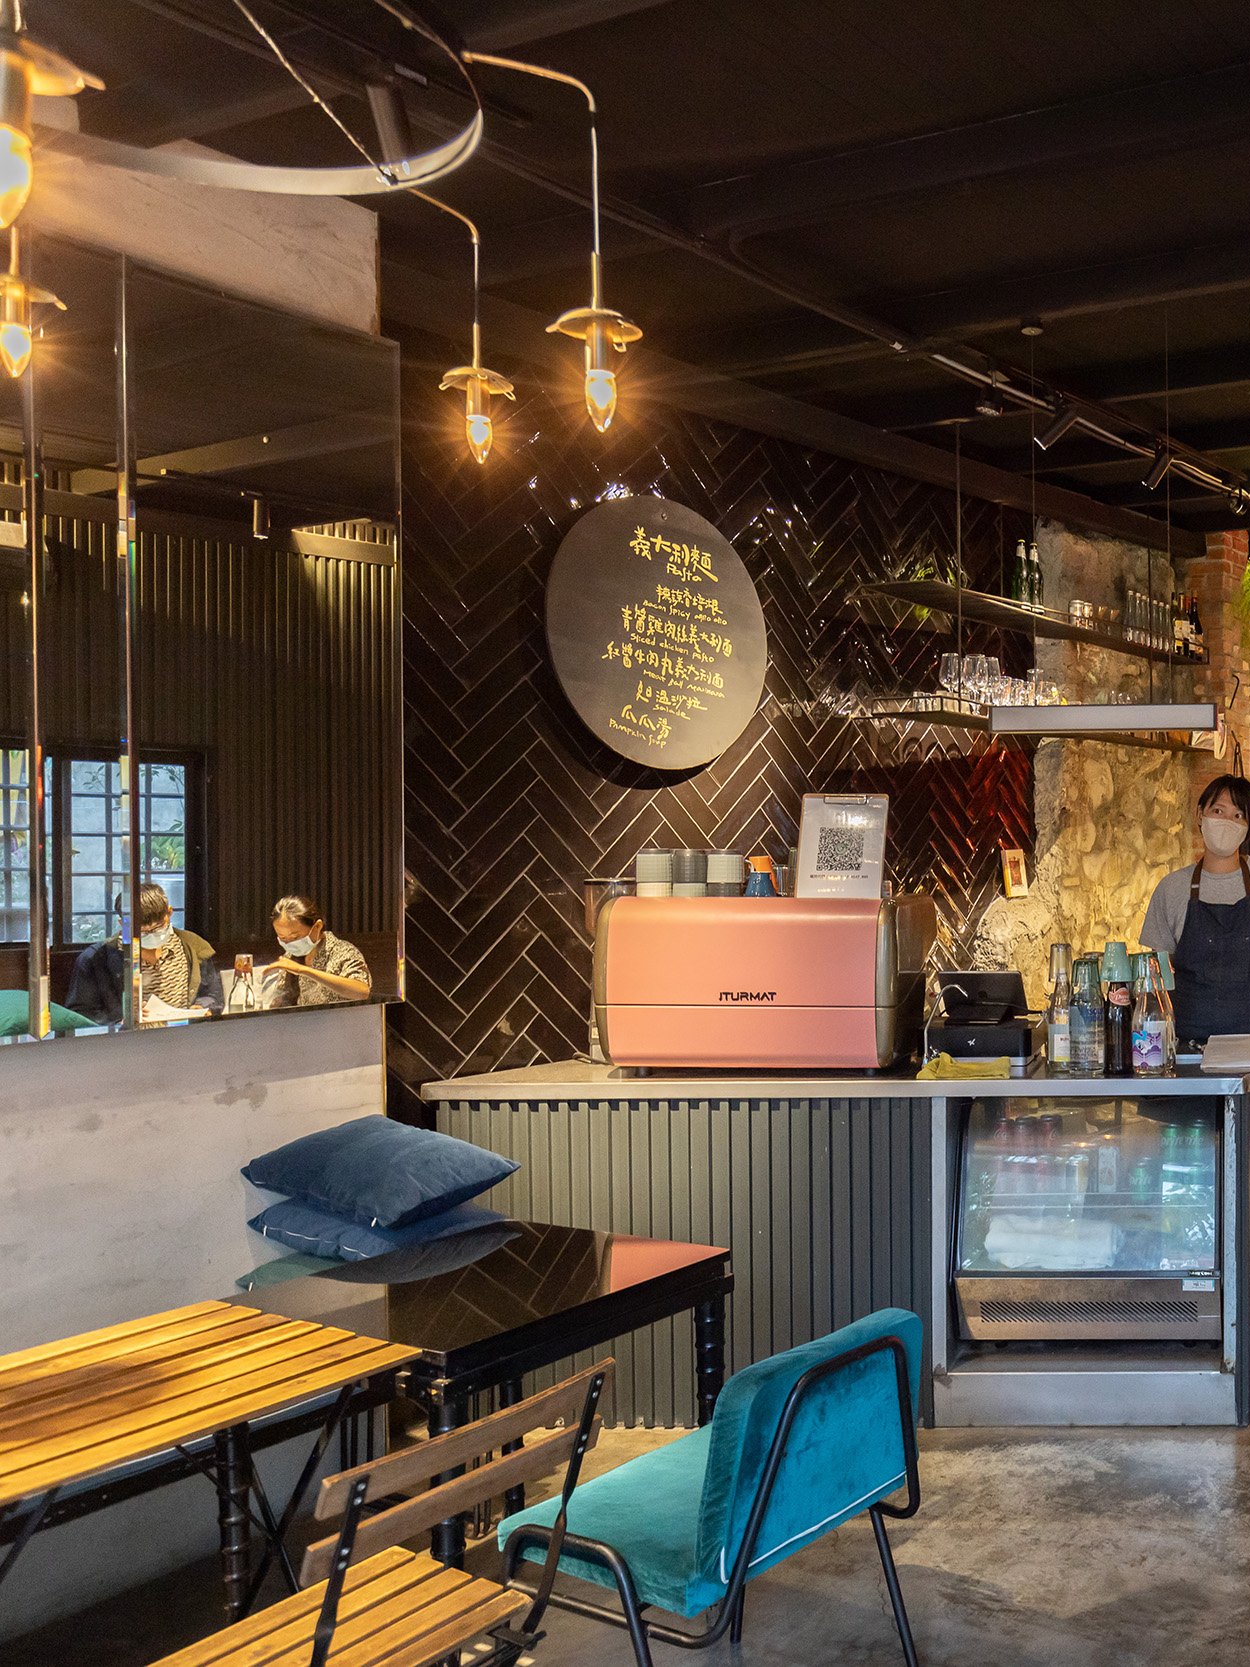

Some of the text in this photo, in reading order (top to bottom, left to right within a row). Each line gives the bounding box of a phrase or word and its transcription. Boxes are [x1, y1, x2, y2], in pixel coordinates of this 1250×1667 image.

[629, 526, 719, 582] 義大利麵
[666, 563, 702, 582] Pasta
[630, 633, 656, 646] Sliced
